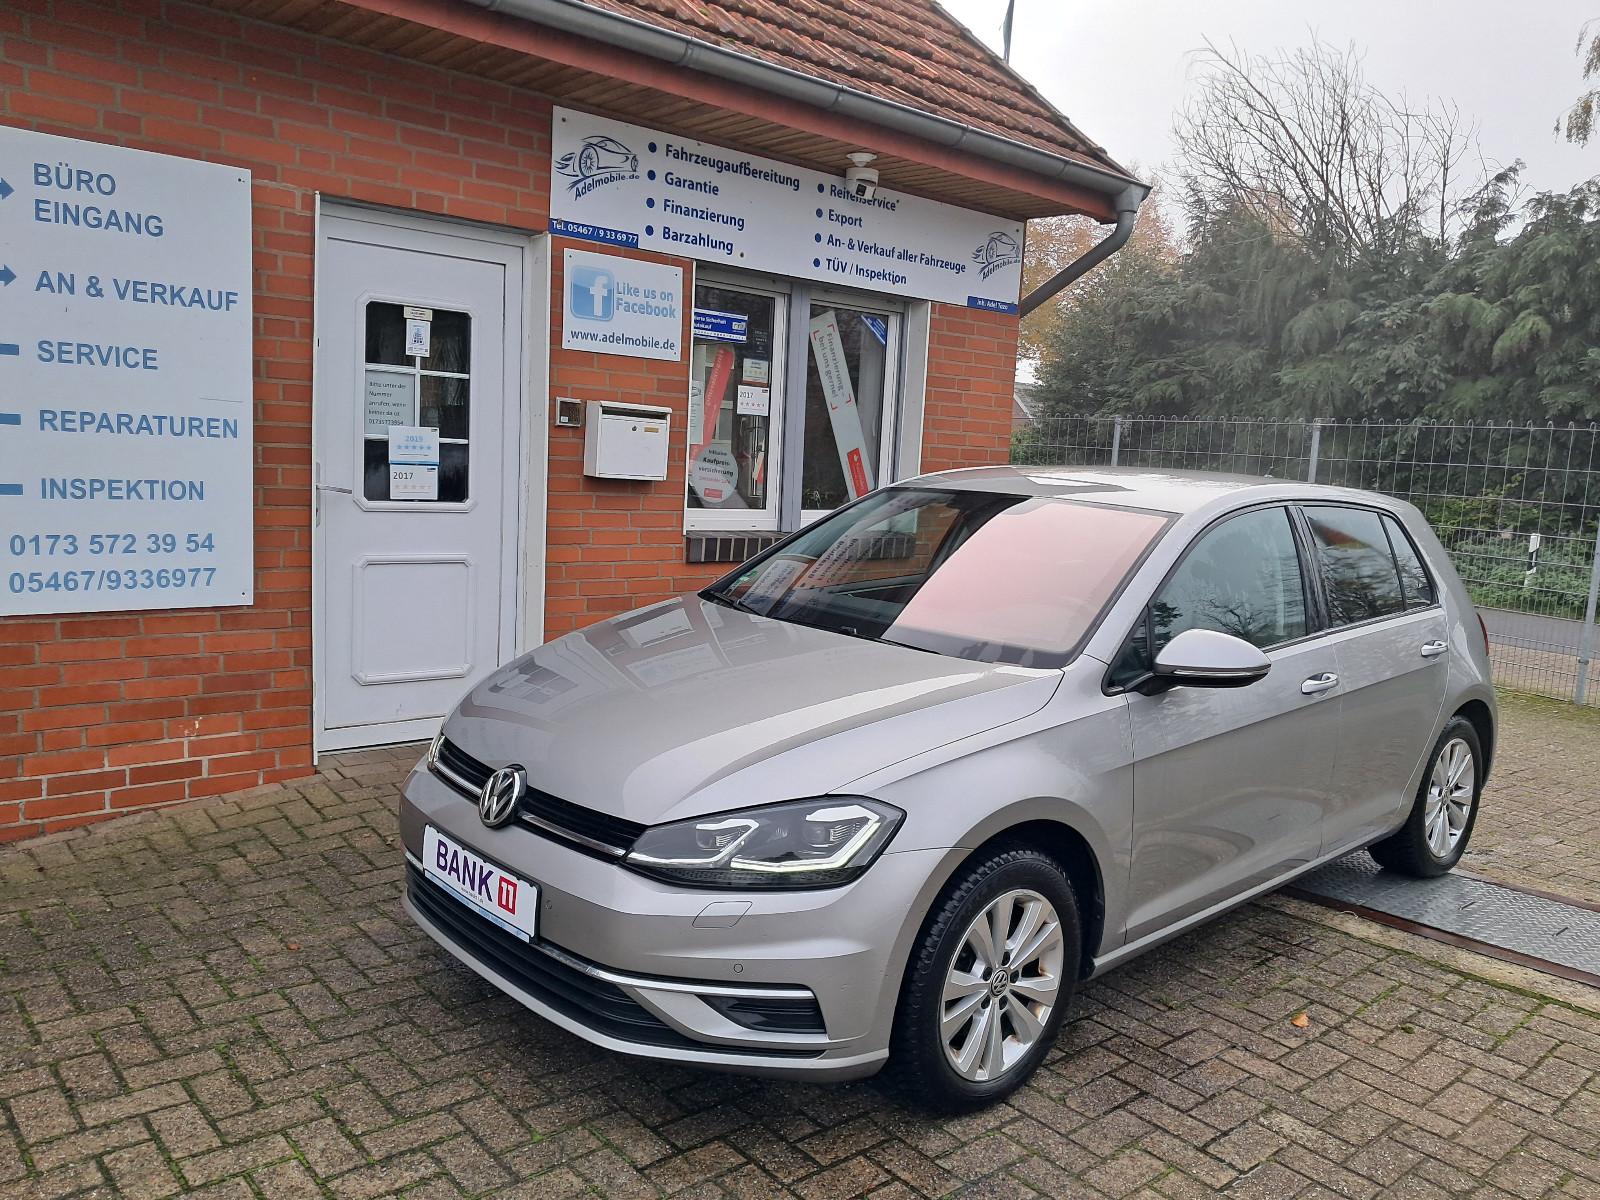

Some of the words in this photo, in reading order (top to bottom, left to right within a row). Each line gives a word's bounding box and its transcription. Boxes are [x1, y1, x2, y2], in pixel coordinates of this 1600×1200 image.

[33, 161, 116, 196] BÜRO
[665, 143, 800, 191] Fahrzeugaufbereitung
[574, 172, 640, 201] Adelmobile.de
[664, 171, 719, 196] Garantie
[34, 198, 164, 237] EINGANG
[663, 198, 745, 231] Finanzierung
[828, 209, 863, 228] Export
[567, 223, 593, 235] 05467
[599, 229, 604, 238] 9
[605, 230, 615, 240] 33
[616, 232, 627, 241] 69
[628, 234, 638, 244] 77
[662, 226, 734, 255] Barzahlung
[826, 233, 845, 248] An-
[847, 238, 856, 251] &
[857, 240, 896, 259] Verkauf
[896, 248, 917, 264] aller
[920, 253, 966, 274] Fahrzeuge
[826, 257, 848, 273] TÜV
[856, 266, 907, 285] Inspektion
[34, 270, 75, 296] AN
[85, 275, 104, 299] &
[112, 278, 239, 312] VERKAUF
[616, 281, 640, 297] Like
[644, 288, 657, 300] us
[660, 290, 673, 302] on
[616, 297, 676, 319] Facebook
[570, 329, 675, 351] www.adelmobile.de
[37, 339, 159, 371] SERVICE
[39, 409, 238, 439] REPARATUREN
[41, 477, 205, 501] INSPEKTION
[393, 471, 414, 480] 2017
[9, 534, 79, 556] 0173
[89, 533, 137, 555] 572
[146, 533, 177, 554] 39
[186, 532, 215, 553] 54
[8, 567, 217, 594] 05467/9336977
[436, 838, 495, 902] BANK
